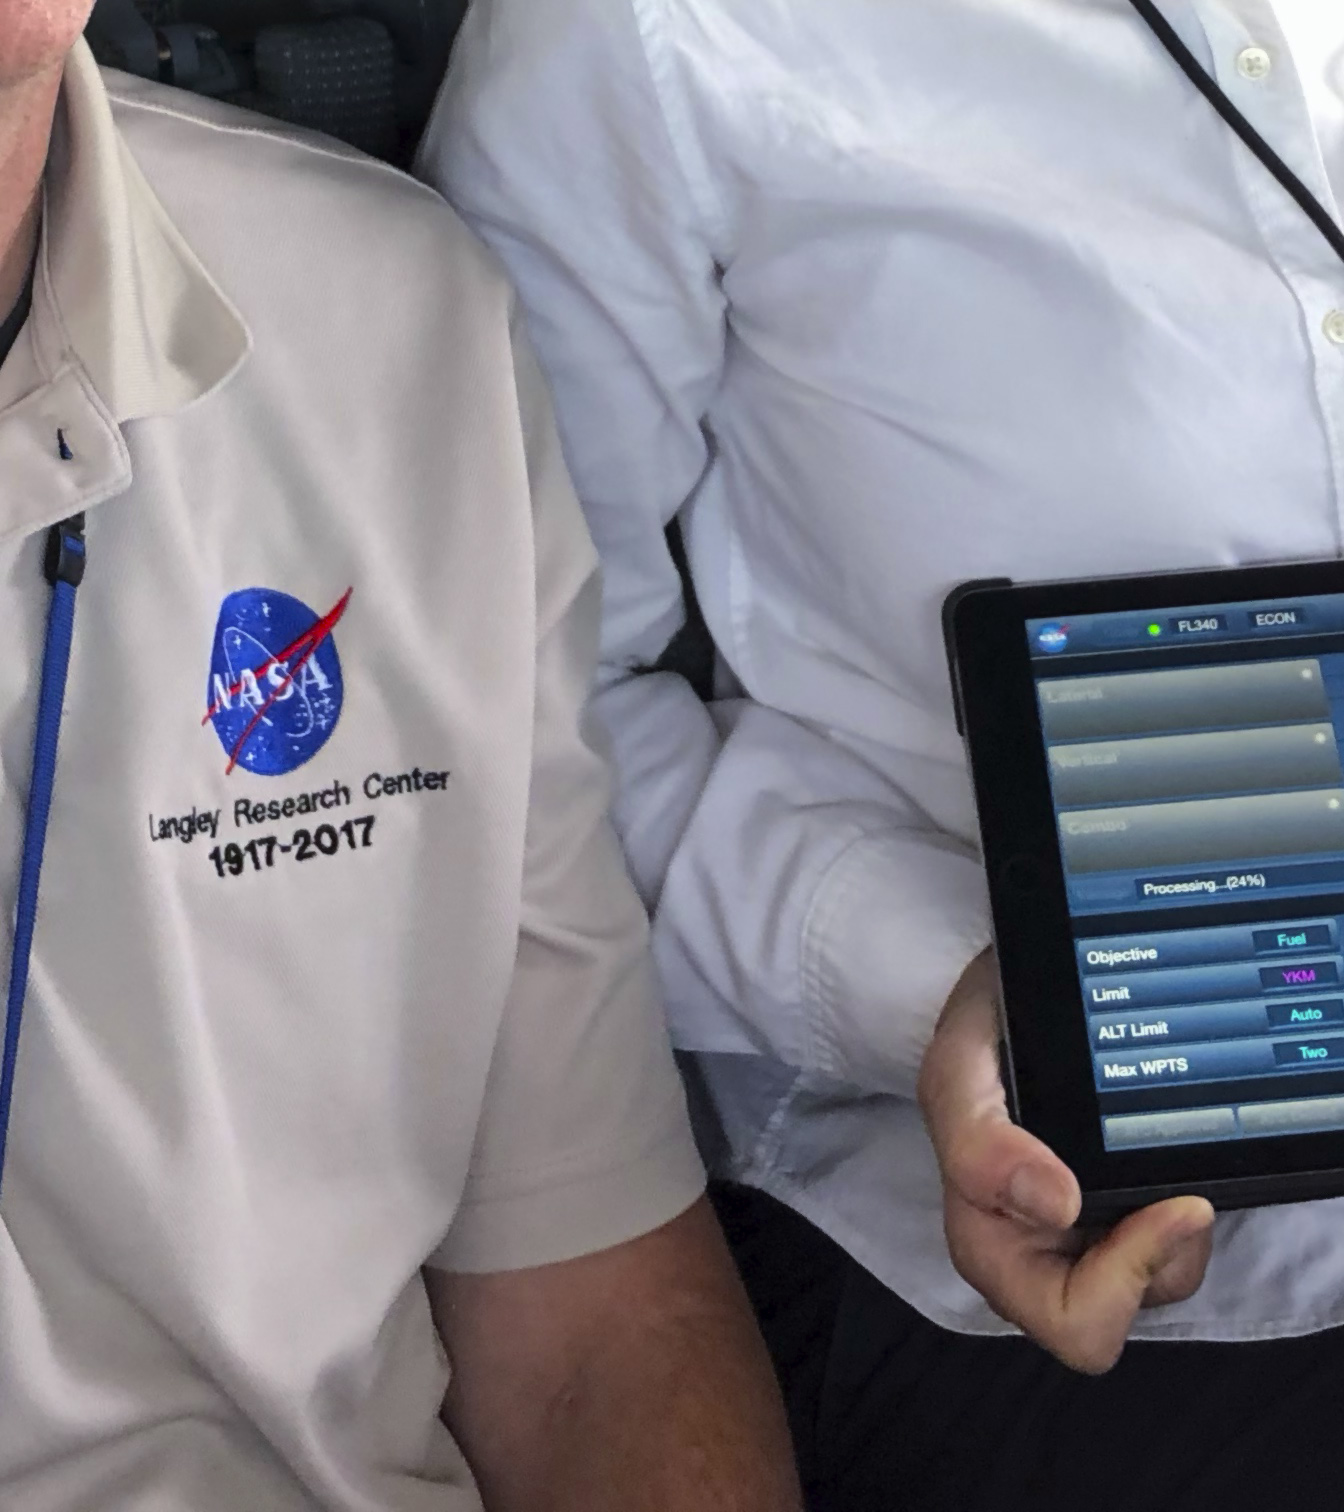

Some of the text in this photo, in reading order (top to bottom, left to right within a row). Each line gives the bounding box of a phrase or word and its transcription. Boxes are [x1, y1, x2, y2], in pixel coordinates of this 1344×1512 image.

[1178, 612, 1296, 633] FL340 ECON
[211, 653, 334, 715] NASA
[149, 767, 451, 844] Langley Research Center
[208, 814, 376, 878] 1917-2017
[1277, 933, 1306, 947] Fuel
[1086, 947, 1158, 965] Objective
[1282, 970, 1316, 984] YKM
[1092, 987, 1131, 1003] Limit
[1290, 1008, 1323, 1022] Auto
[1098, 1021, 1169, 1040] ALT Limit
[1298, 1046, 1328, 1060] Two
[1103, 1058, 1189, 1079] Max WPTS
